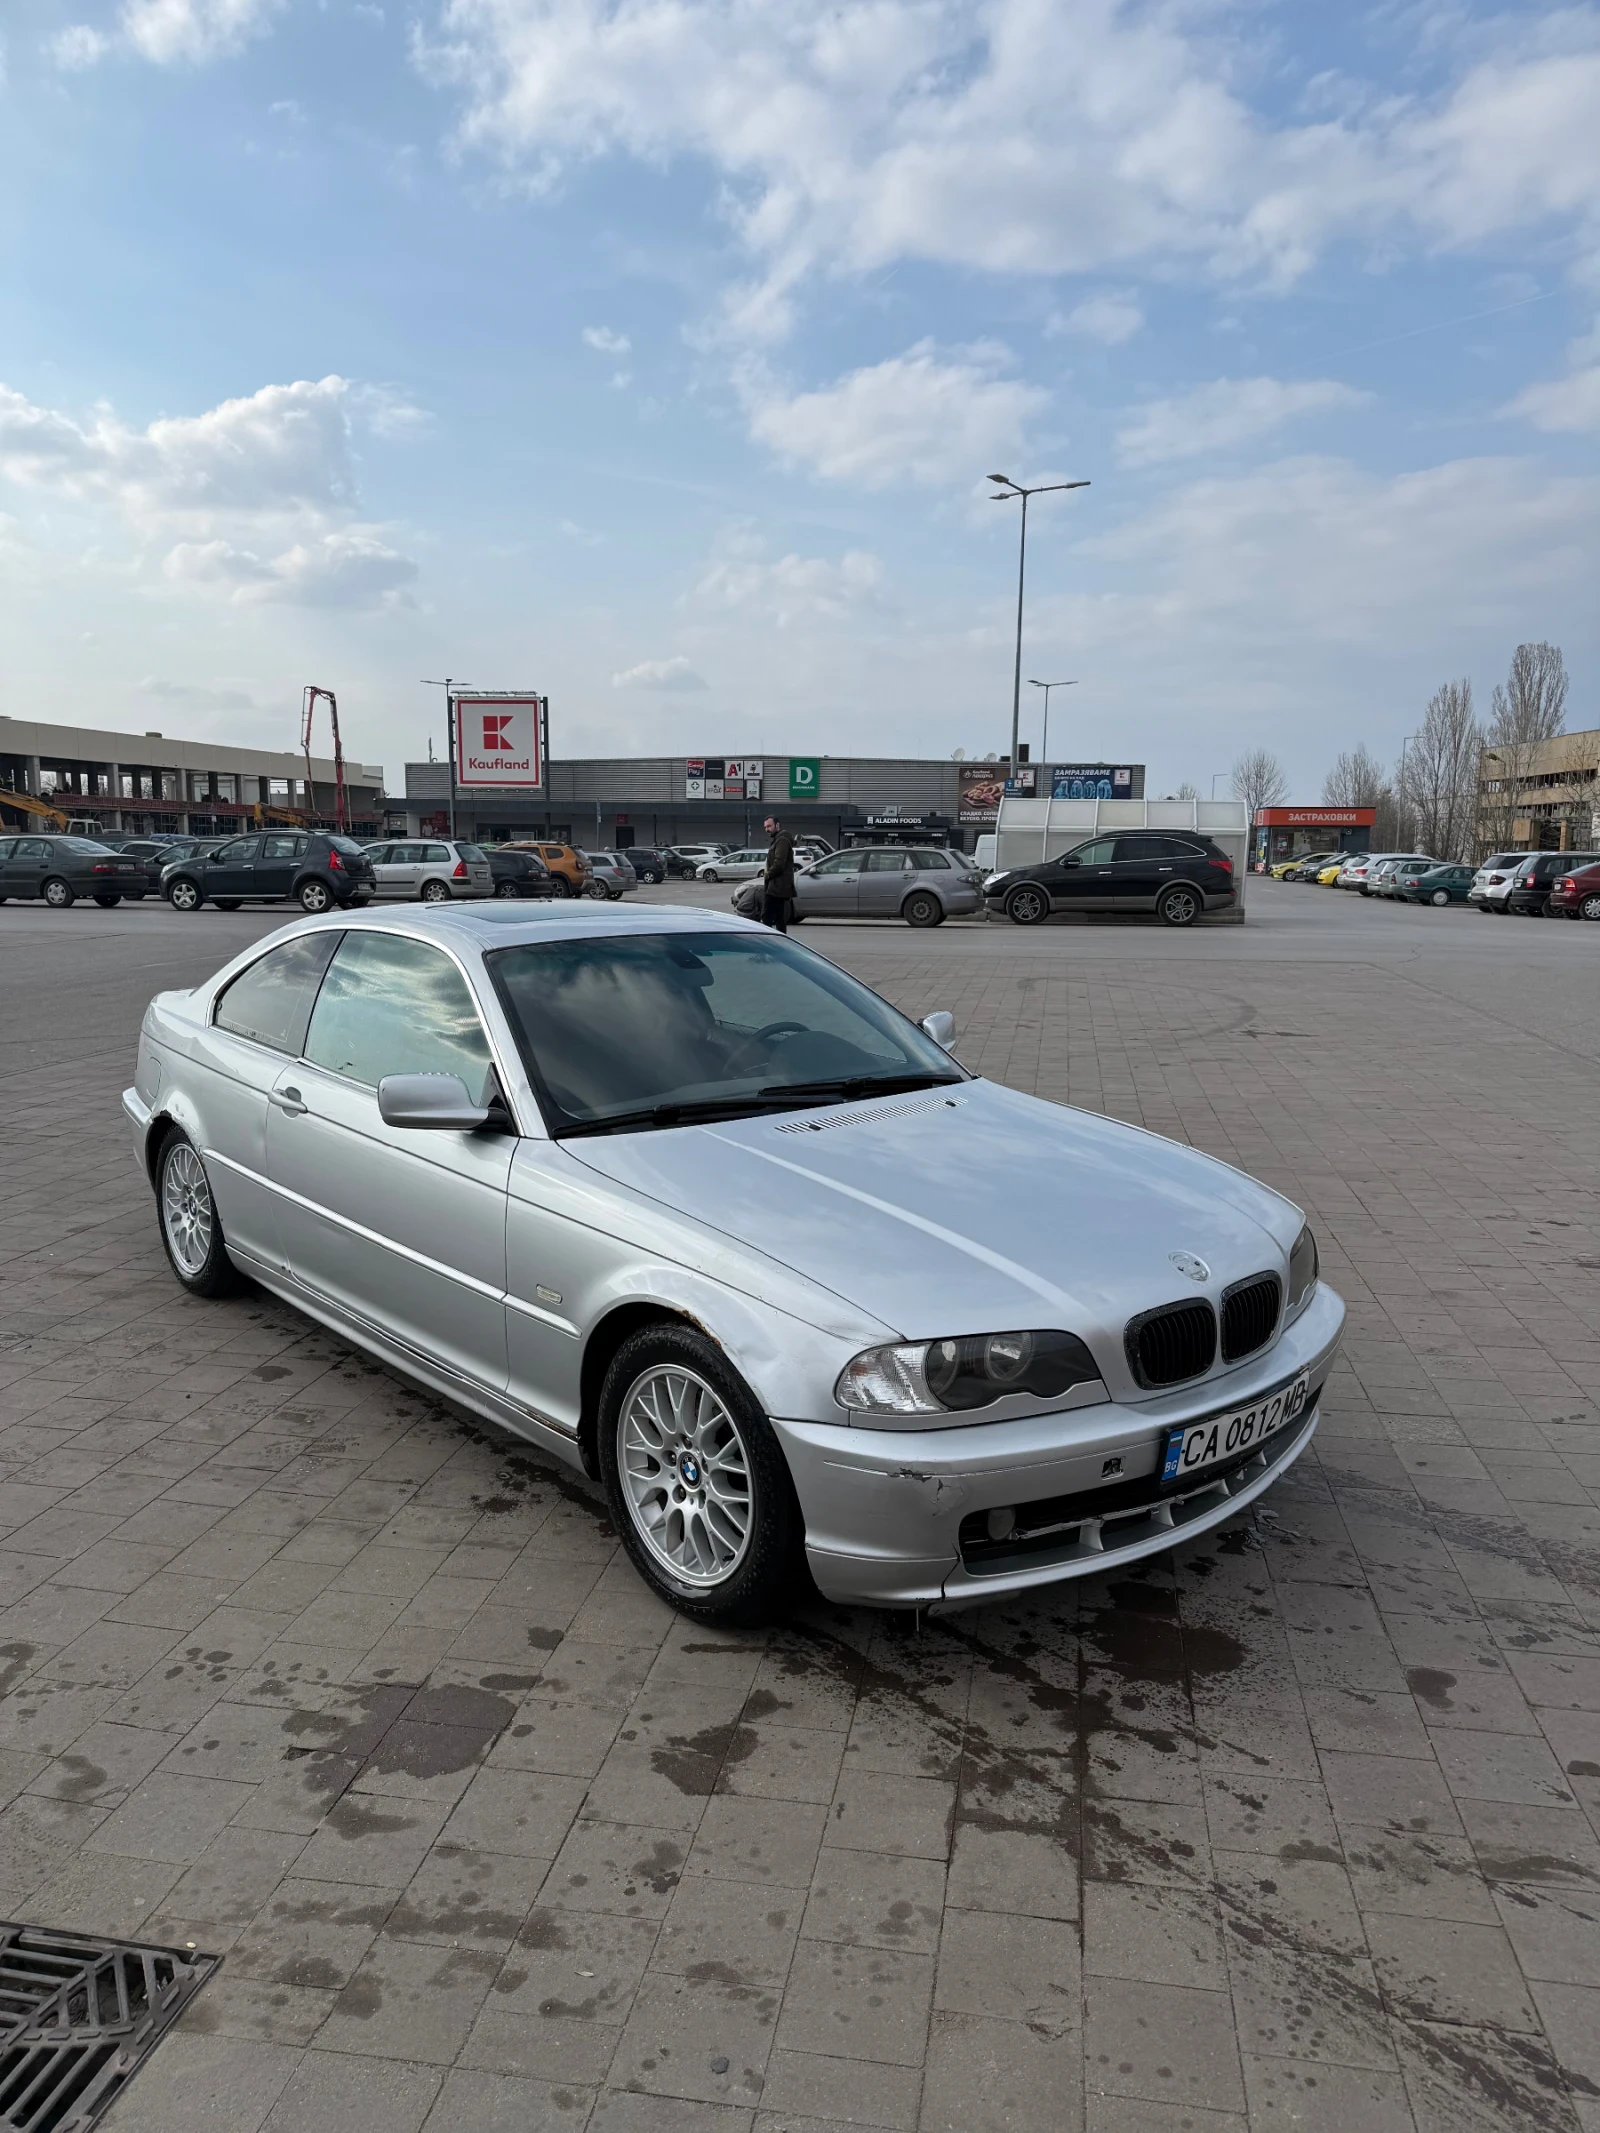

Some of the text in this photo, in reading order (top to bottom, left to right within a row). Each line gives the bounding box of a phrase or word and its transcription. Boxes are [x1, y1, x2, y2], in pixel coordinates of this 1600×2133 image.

[469, 758, 529, 770] Kaufland
[727, 763, 742, 777] A1
[796, 766, 813, 784] D
[1054, 779, 1112, 799] 4000
[1288, 813, 1356, 821] ЗАСТРАХОВКИ
[1183, 1424, 1218, 1467] CA
[1225, 1401, 1281, 1452] 0812
[1164, 1460, 1178, 1473] BG
